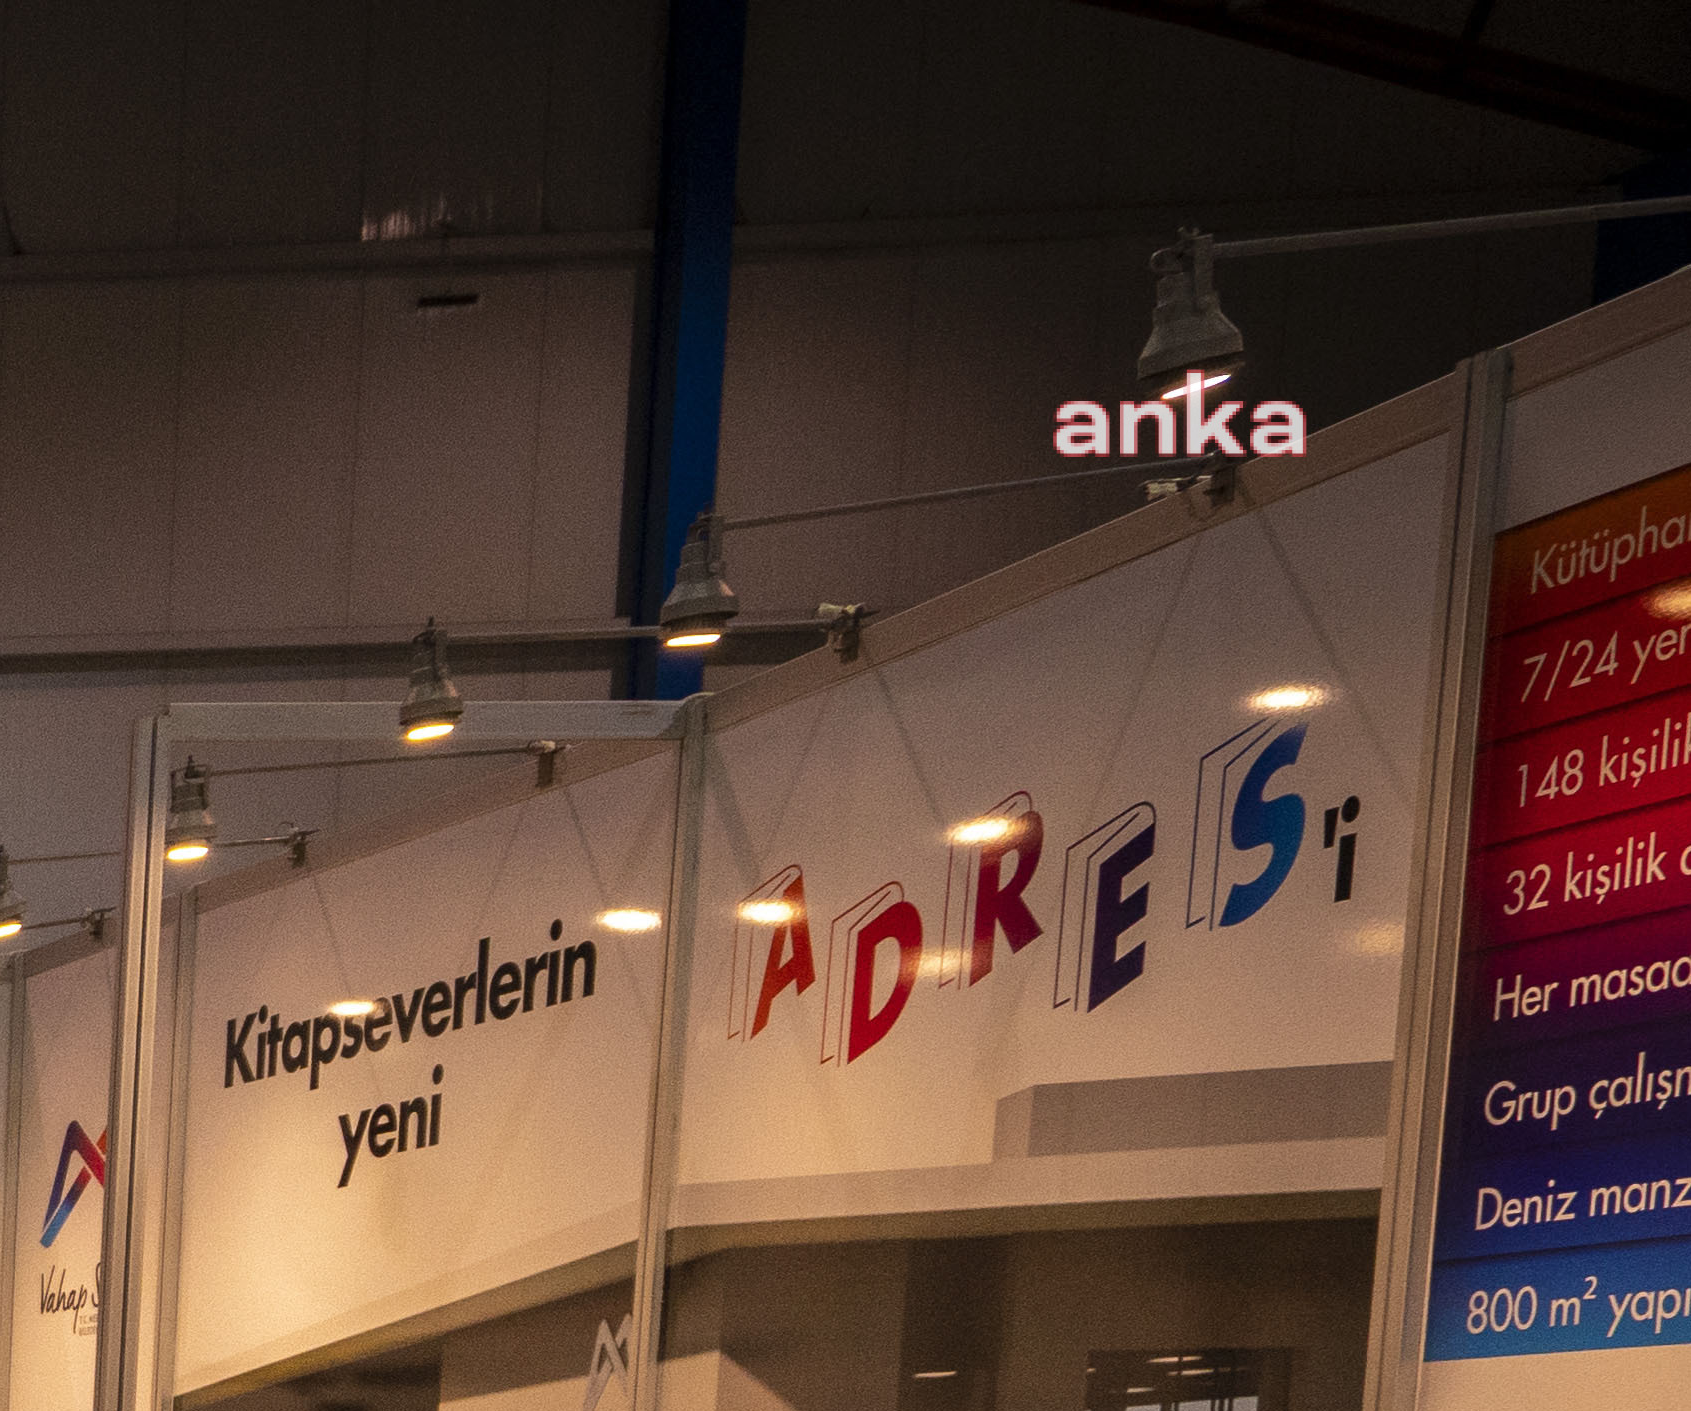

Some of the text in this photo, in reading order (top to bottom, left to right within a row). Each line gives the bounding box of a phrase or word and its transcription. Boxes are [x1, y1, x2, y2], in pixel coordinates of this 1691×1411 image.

[1531, 506, 1691, 594] Kütüpha
[1521, 631, 1619, 703] 7/24
[1519, 749, 1584, 807] 148
[728, 720, 1362, 1067] ADRES'i
[1503, 831, 1667, 915] 32 kişilik
[224, 920, 597, 1090] Kitapseverlerin
[1493, 974, 1559, 1021] Her
[337, 1065, 444, 1187] yeni
[1484, 1079, 1577, 1131] Grup
[1475, 1179, 1578, 1231] Deniz
[41, 1265, 87, 1334] Vahap
[1467, 1276, 1598, 1334] 800 m²
